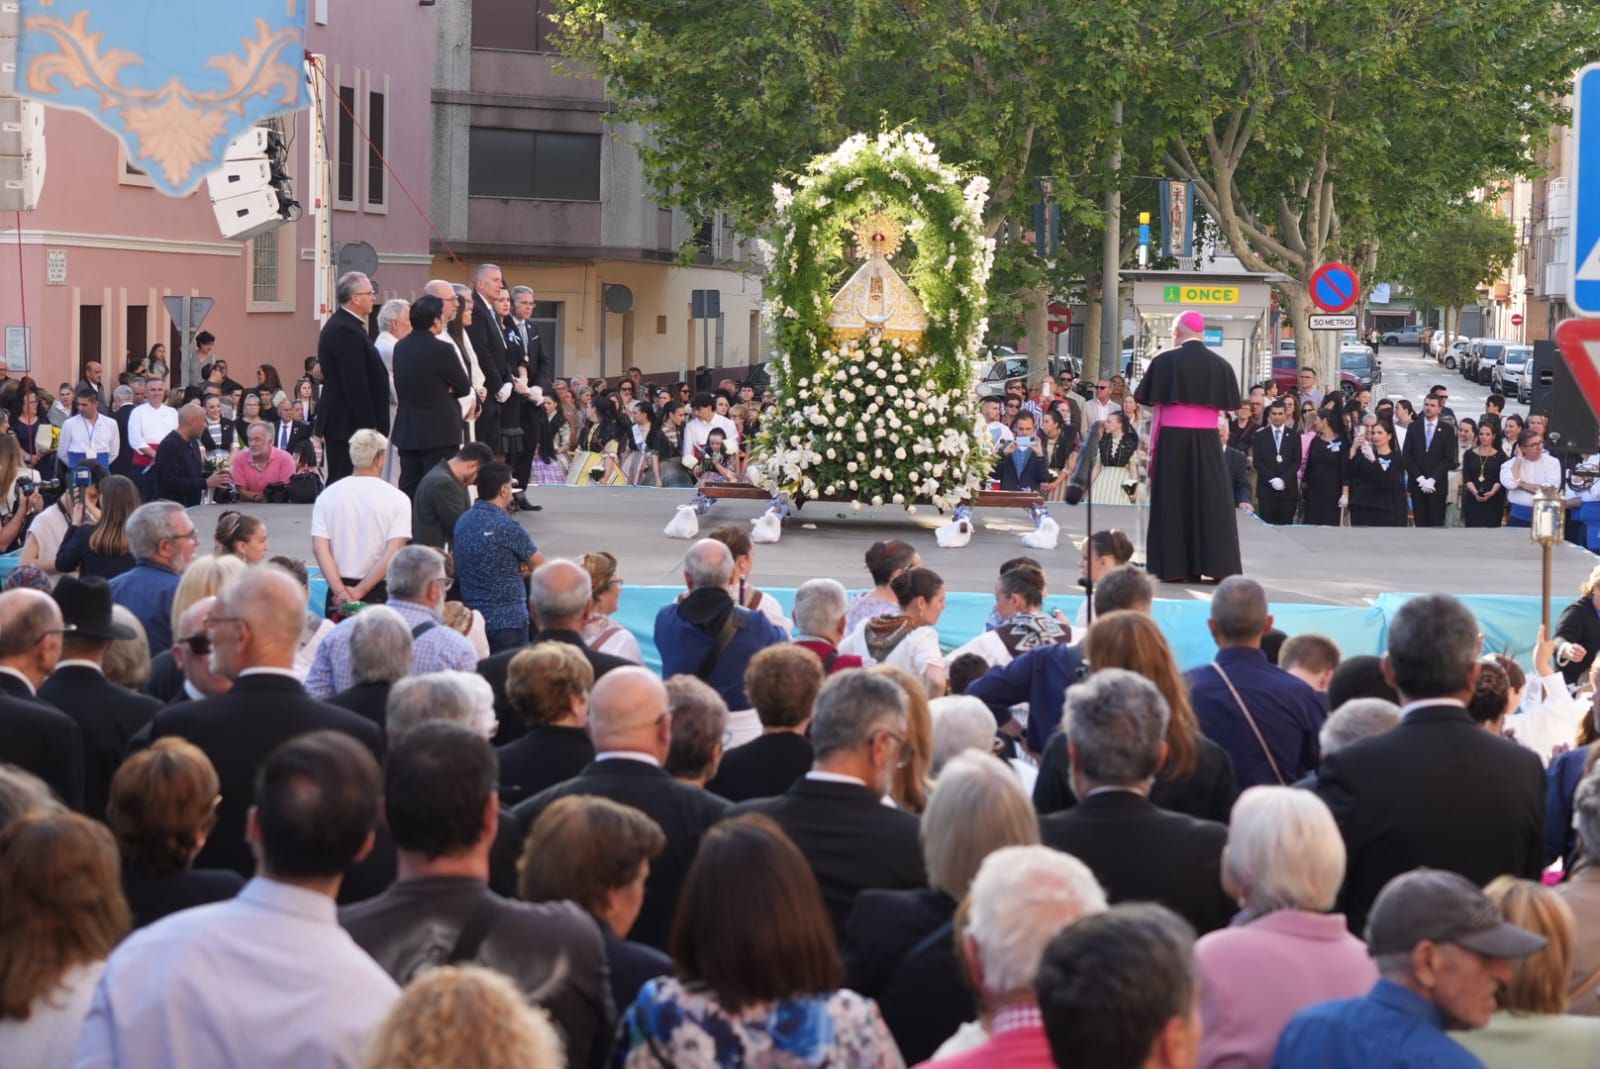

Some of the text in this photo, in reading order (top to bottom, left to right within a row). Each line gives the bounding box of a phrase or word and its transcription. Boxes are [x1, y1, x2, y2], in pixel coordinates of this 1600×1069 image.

[1186, 288, 1233, 301] ONCE
[1313, 318, 1355, 327] 50 METROS
